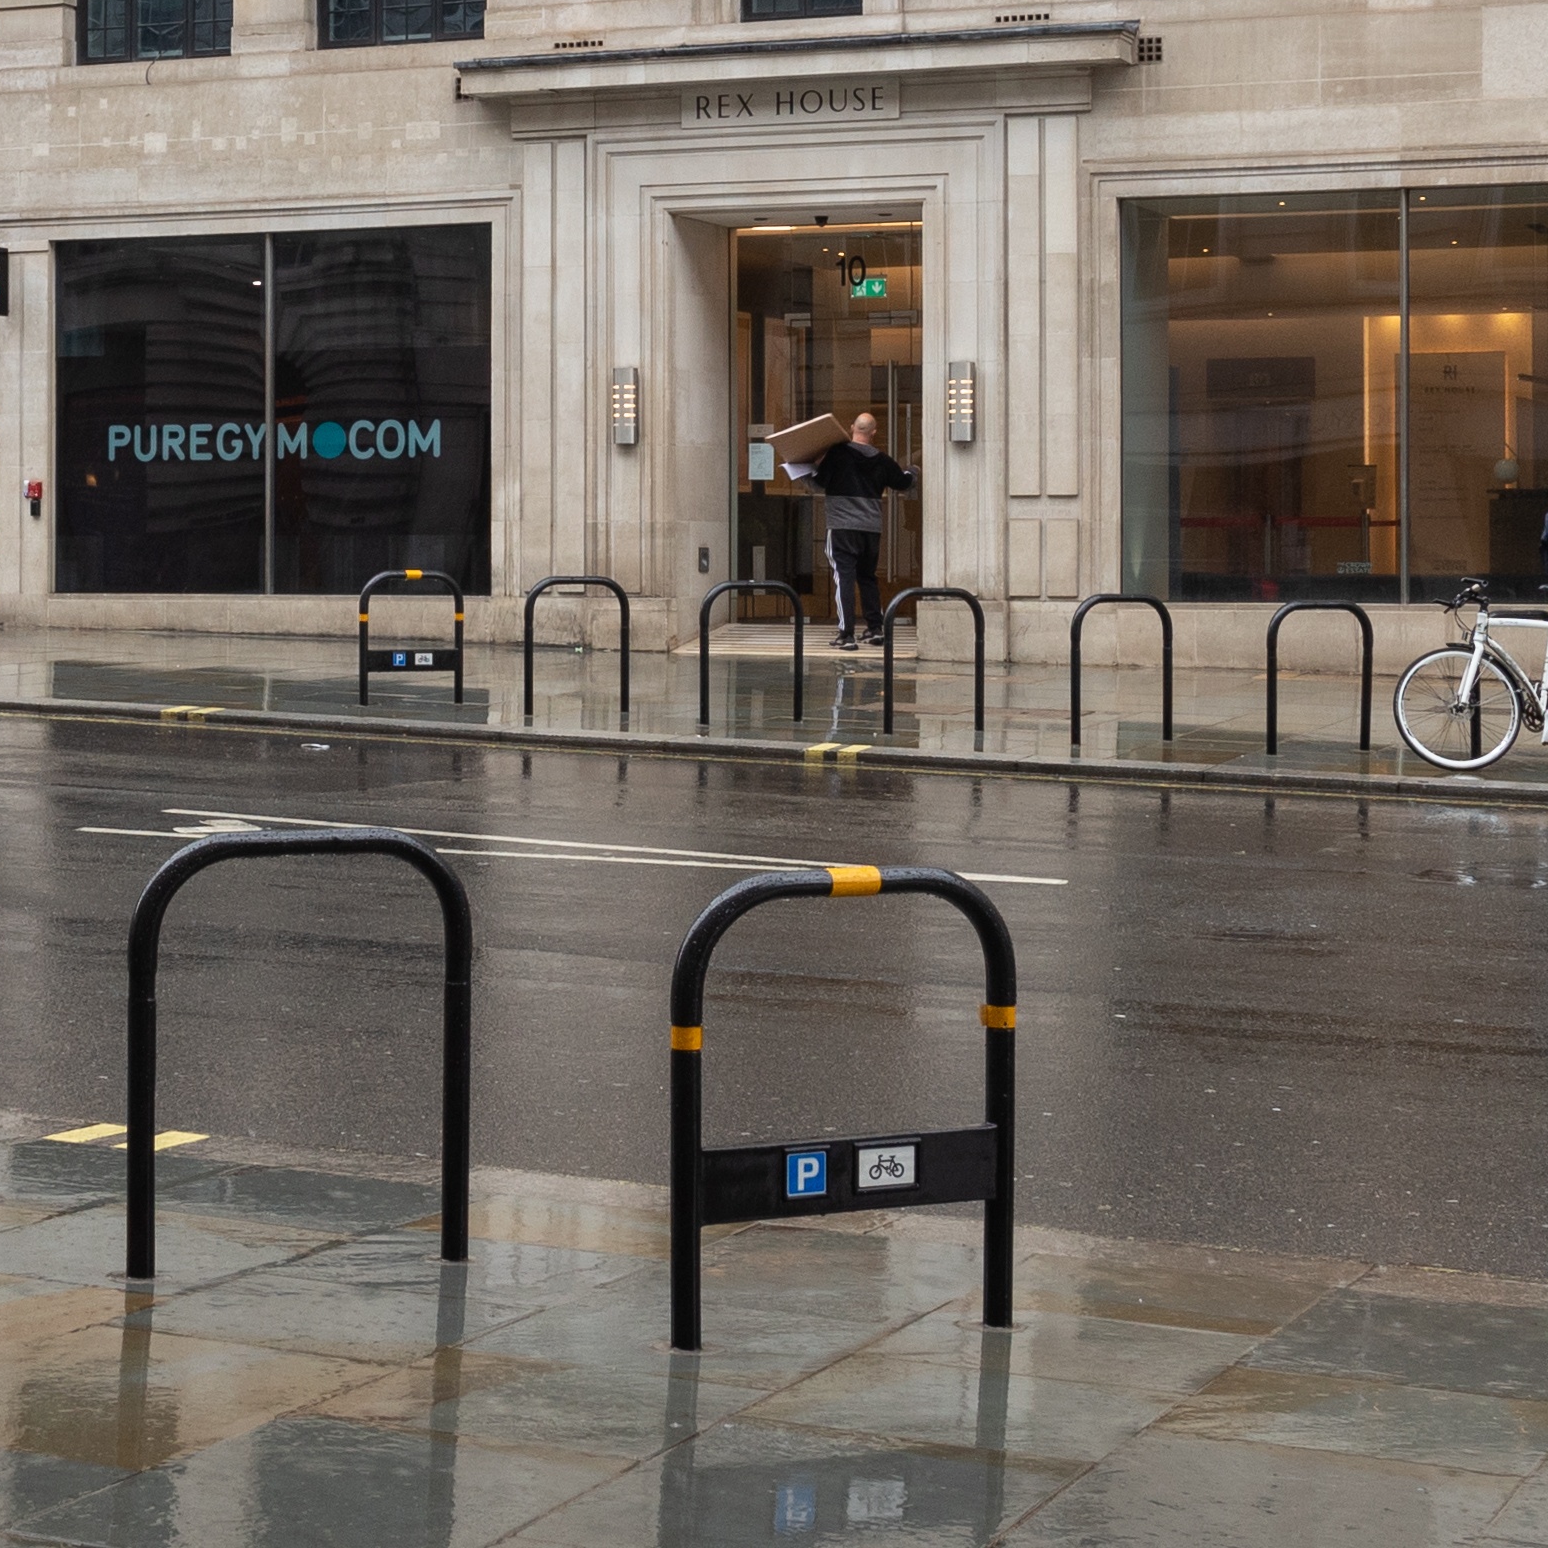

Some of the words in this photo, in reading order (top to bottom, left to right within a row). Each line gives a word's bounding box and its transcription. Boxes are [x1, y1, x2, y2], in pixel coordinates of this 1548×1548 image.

[695, 93, 754, 120] REX
[775, 86, 884, 116] HOUSE
[835, 255, 867, 287] 10
[395, 653, 404, 665] P
[797, 1156, 820, 1191] P
